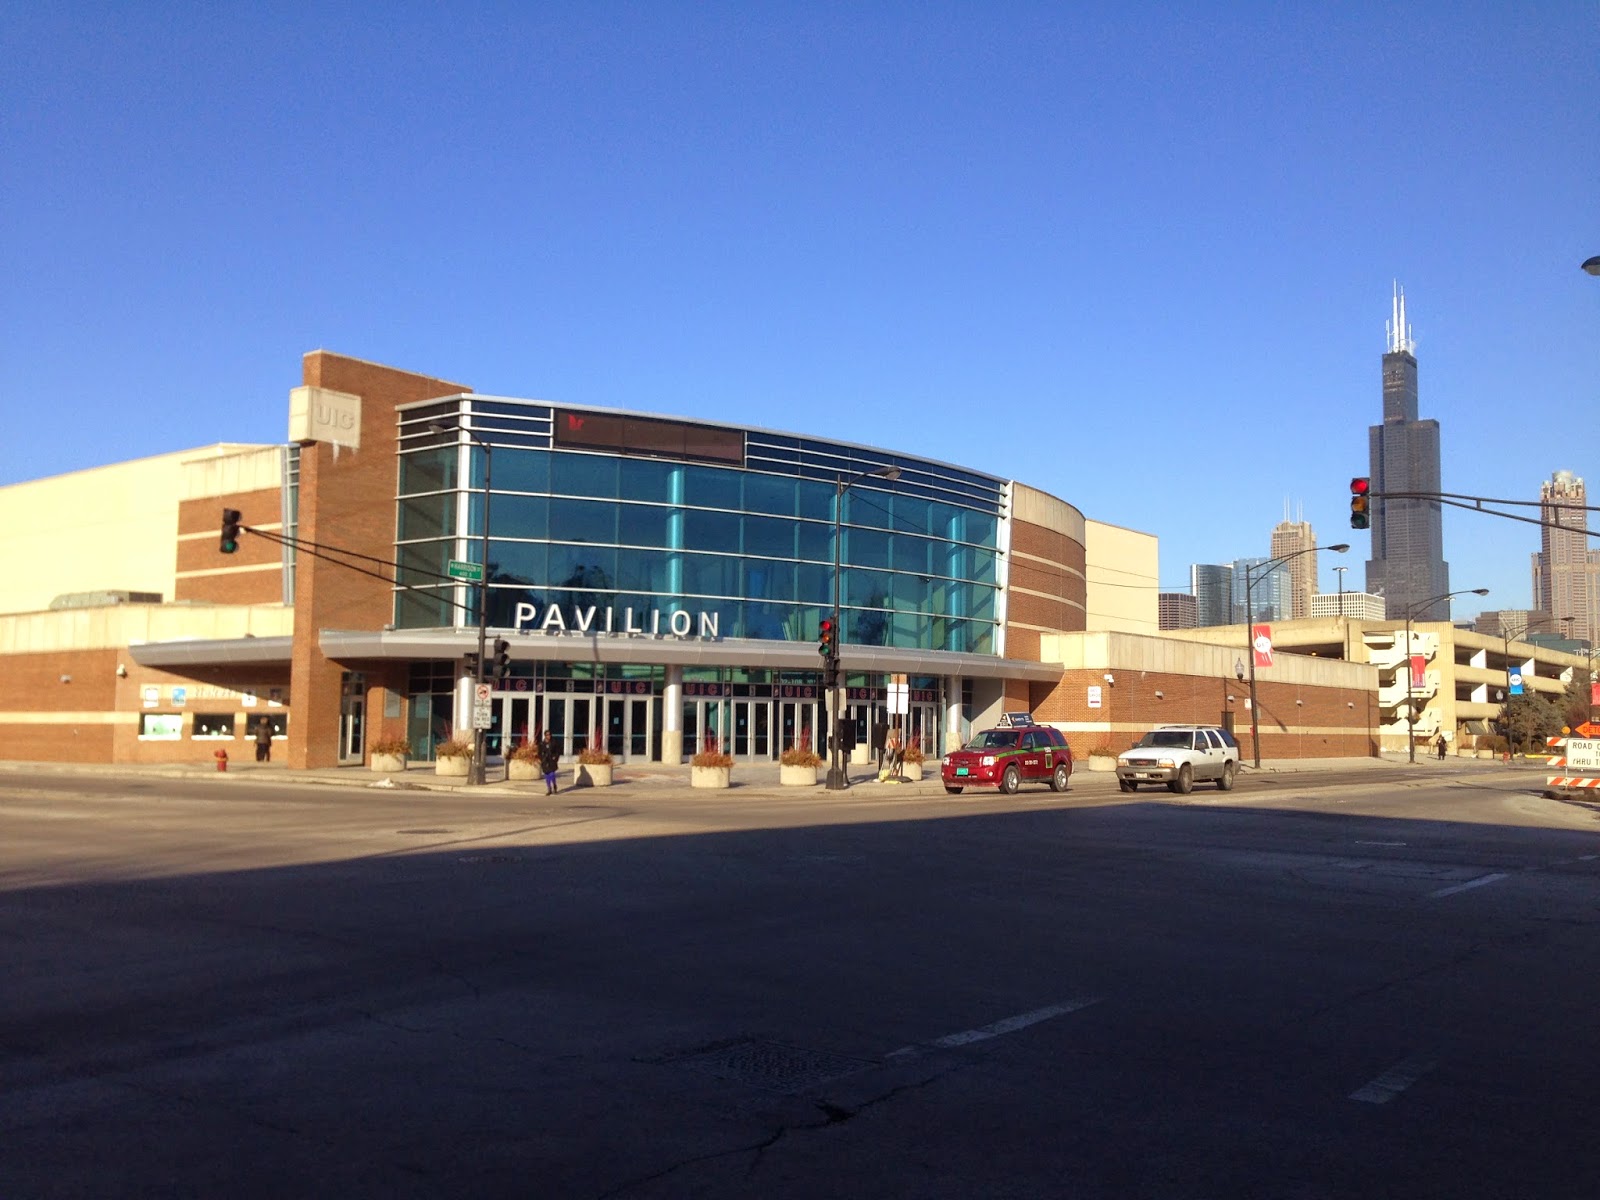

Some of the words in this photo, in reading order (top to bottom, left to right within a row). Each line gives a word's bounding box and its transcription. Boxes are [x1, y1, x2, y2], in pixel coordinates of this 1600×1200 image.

[317, 403, 355, 430] UIC
[514, 602, 718, 637] PAVILION
[610, 681, 646, 693] UIC
[686, 683, 717, 695] UIC
[785, 685, 812, 697] UIC
[1572, 742, 1593, 750] ROAD
